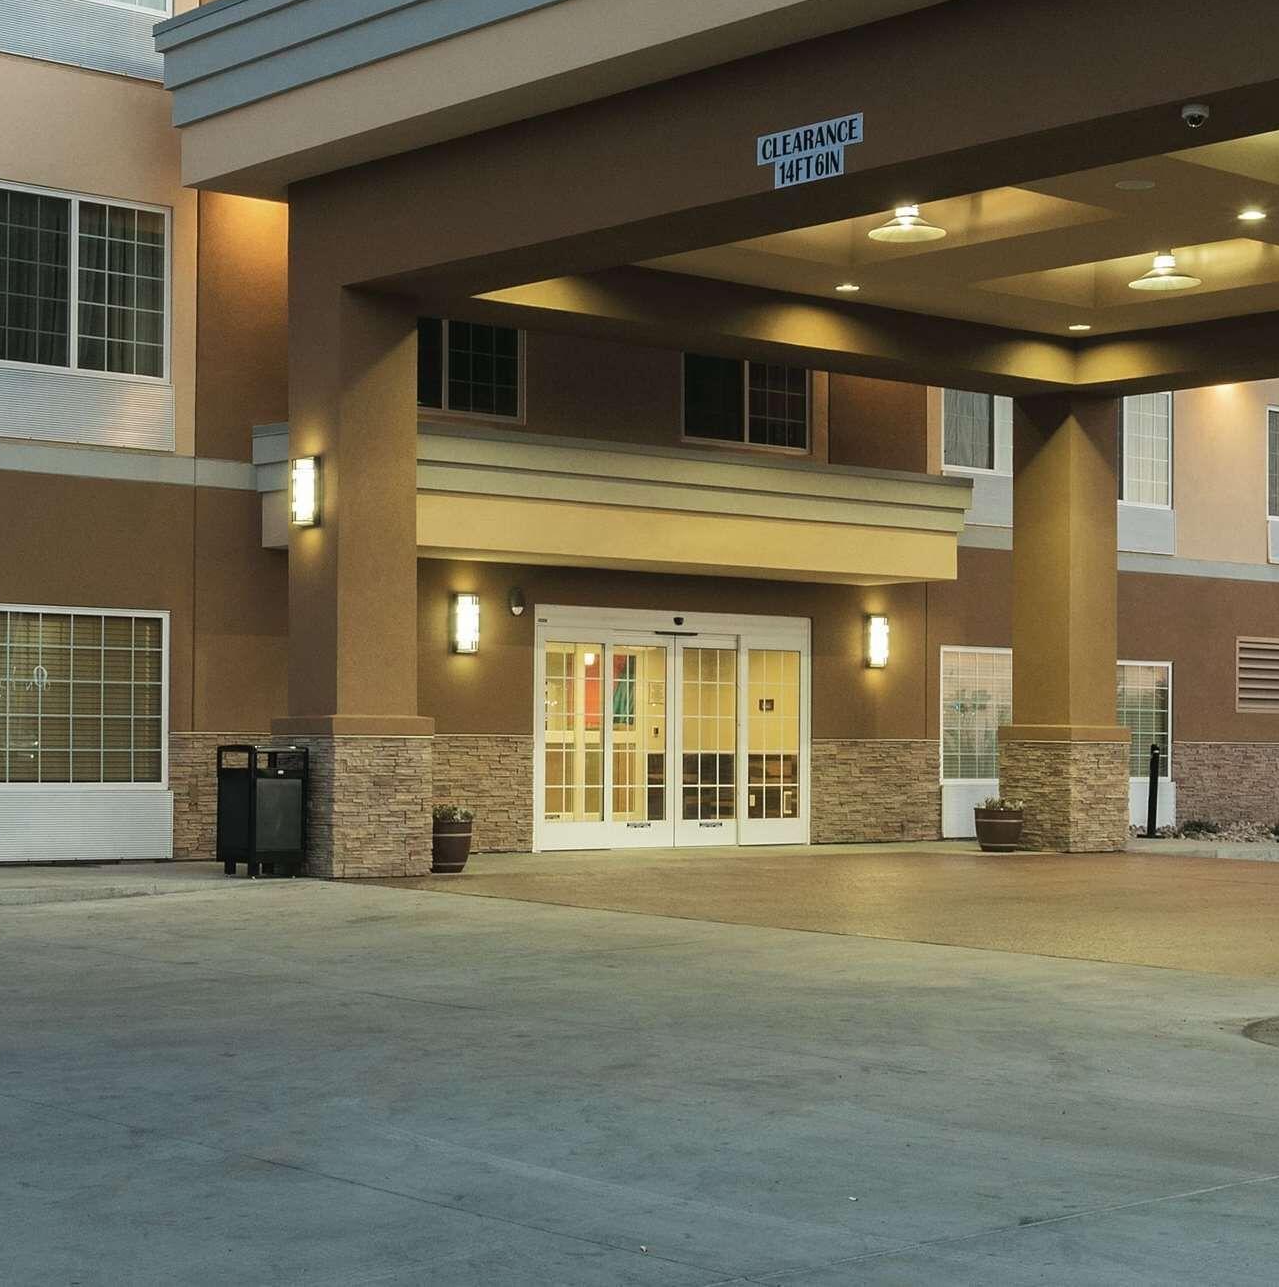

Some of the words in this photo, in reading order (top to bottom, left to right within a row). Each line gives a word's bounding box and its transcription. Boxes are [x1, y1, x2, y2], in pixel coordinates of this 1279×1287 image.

[761, 117, 858, 161] CLEARANCE
[779, 155, 813, 185] 14FT
[814, 150, 840, 176] 6IN
